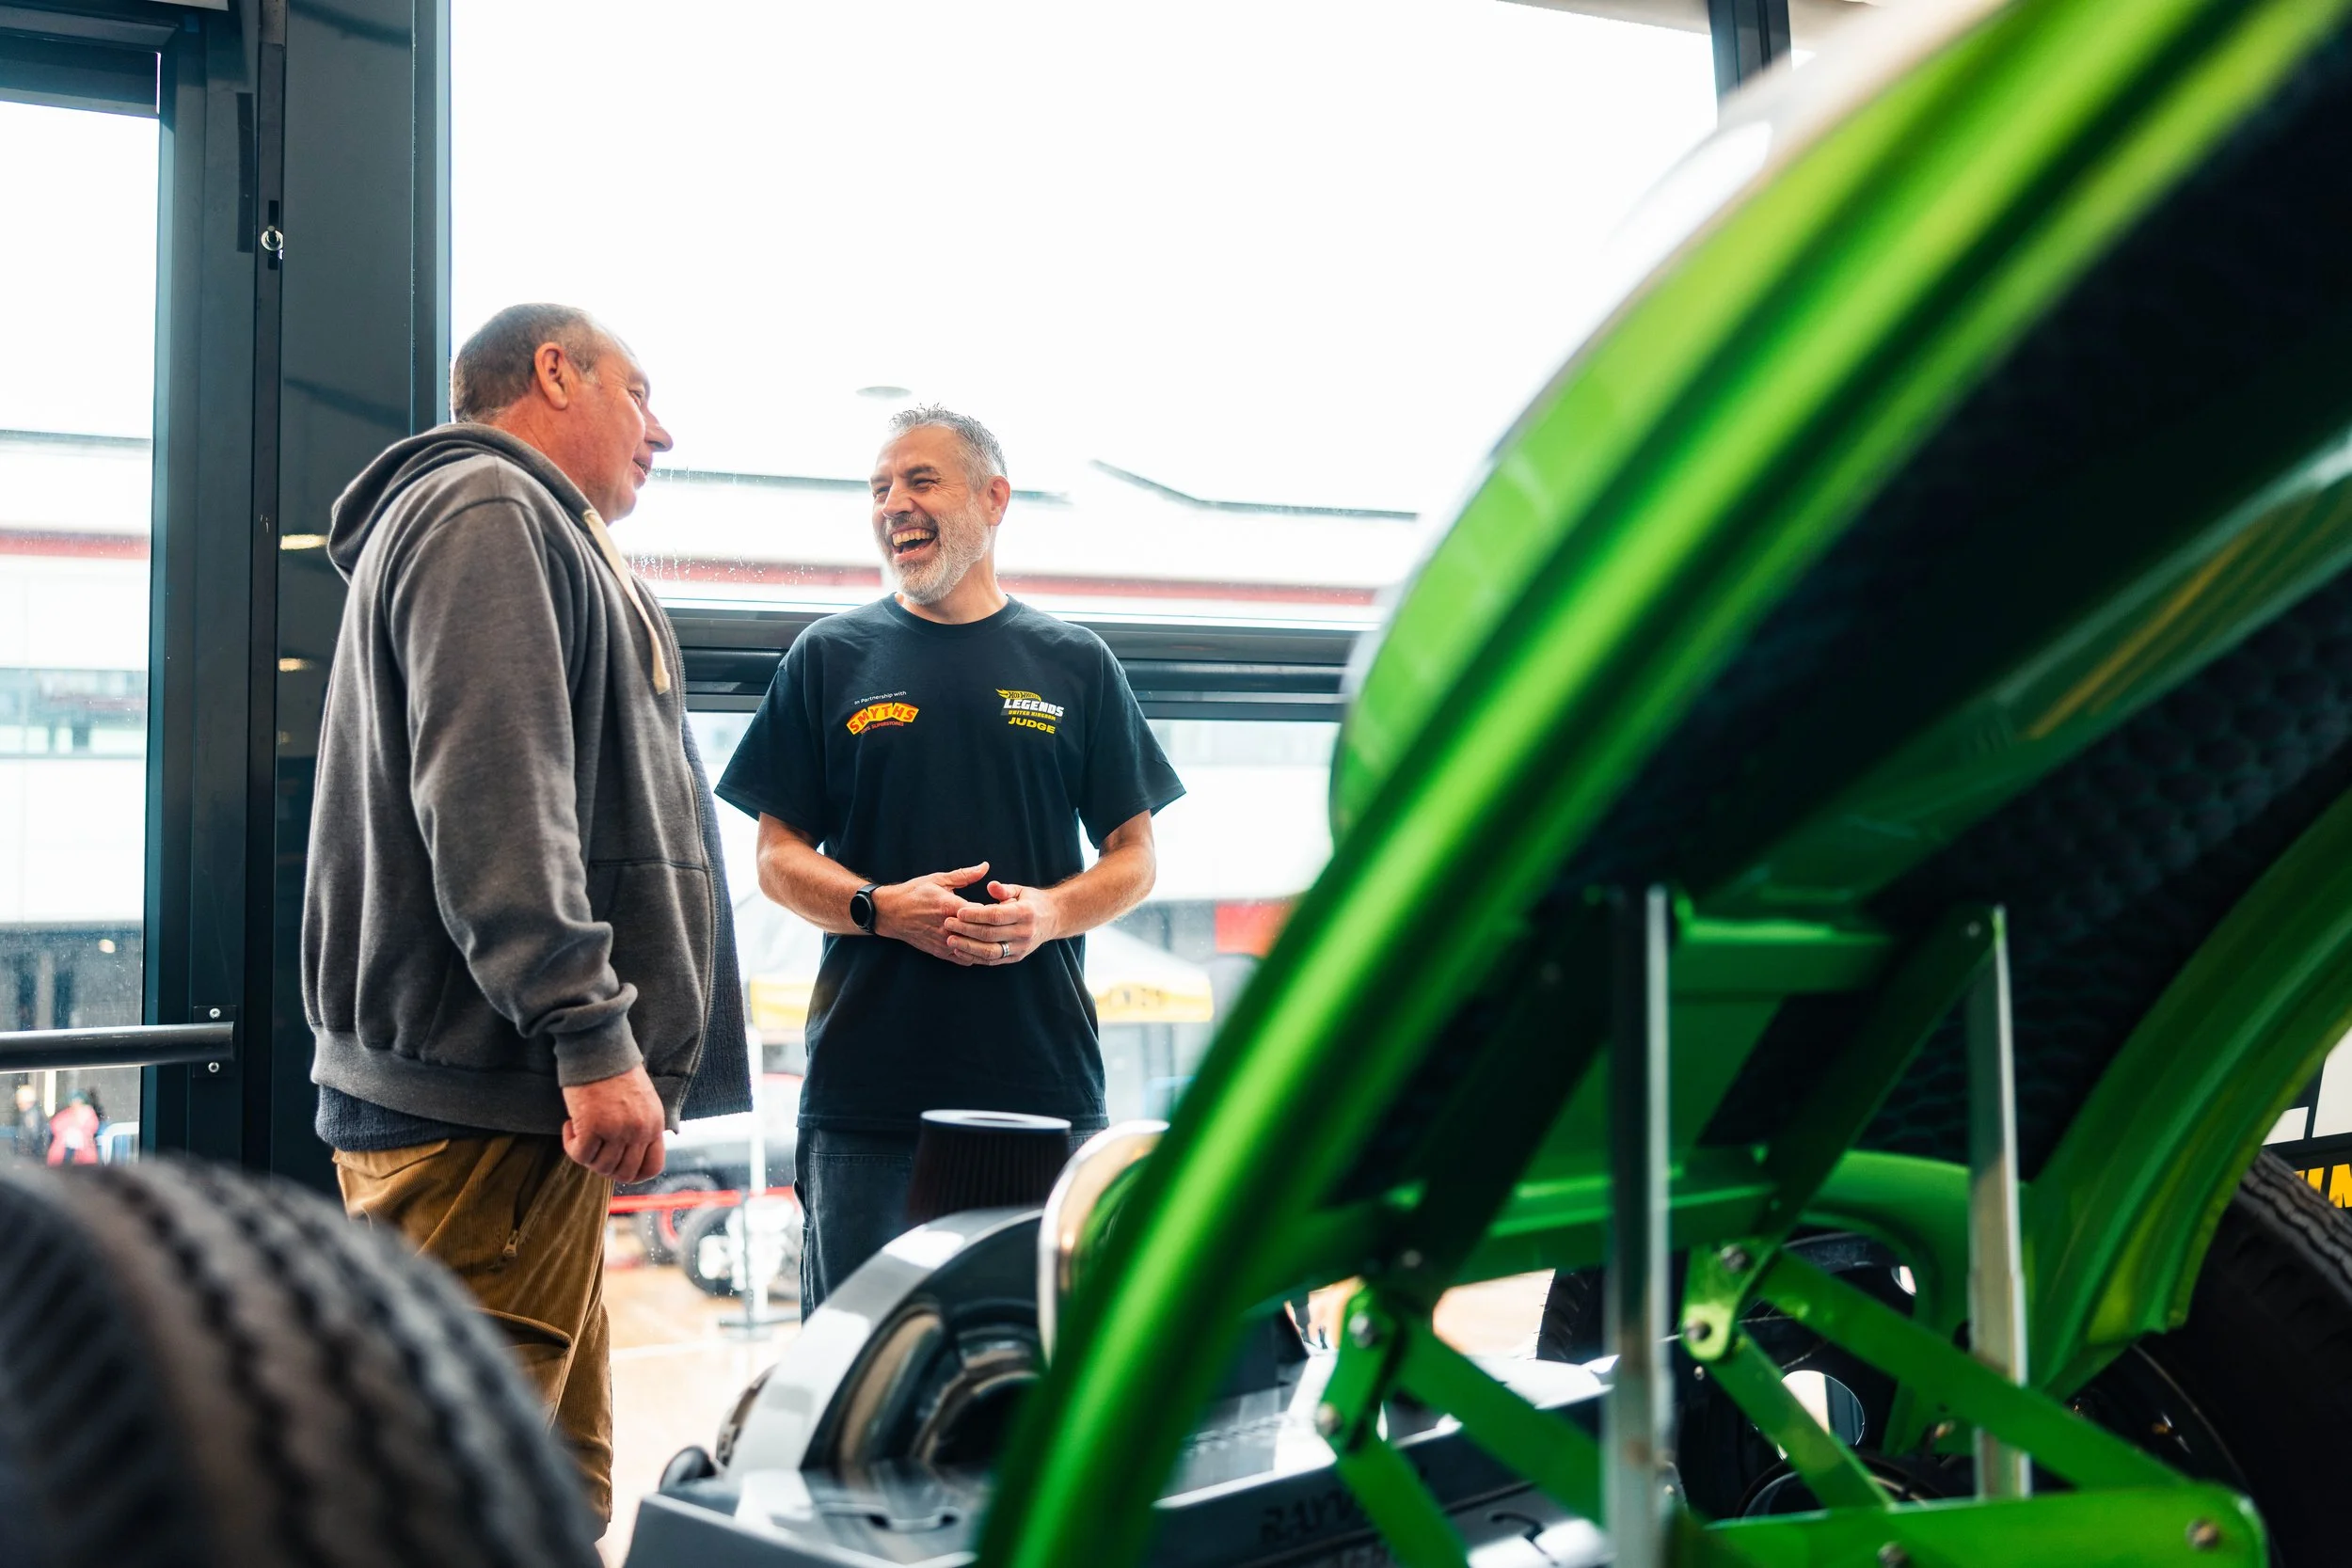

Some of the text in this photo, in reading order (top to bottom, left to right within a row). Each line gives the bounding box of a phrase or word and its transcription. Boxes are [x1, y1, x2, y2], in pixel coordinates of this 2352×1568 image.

[861, 693, 894, 703] Partnership
[1004, 698, 1064, 717] LEGENDS
[1030, 711, 1056, 721] KINGDOM
[849, 705, 916, 733] SMYTHS
[1009, 717, 1056, 734] JUDGE
